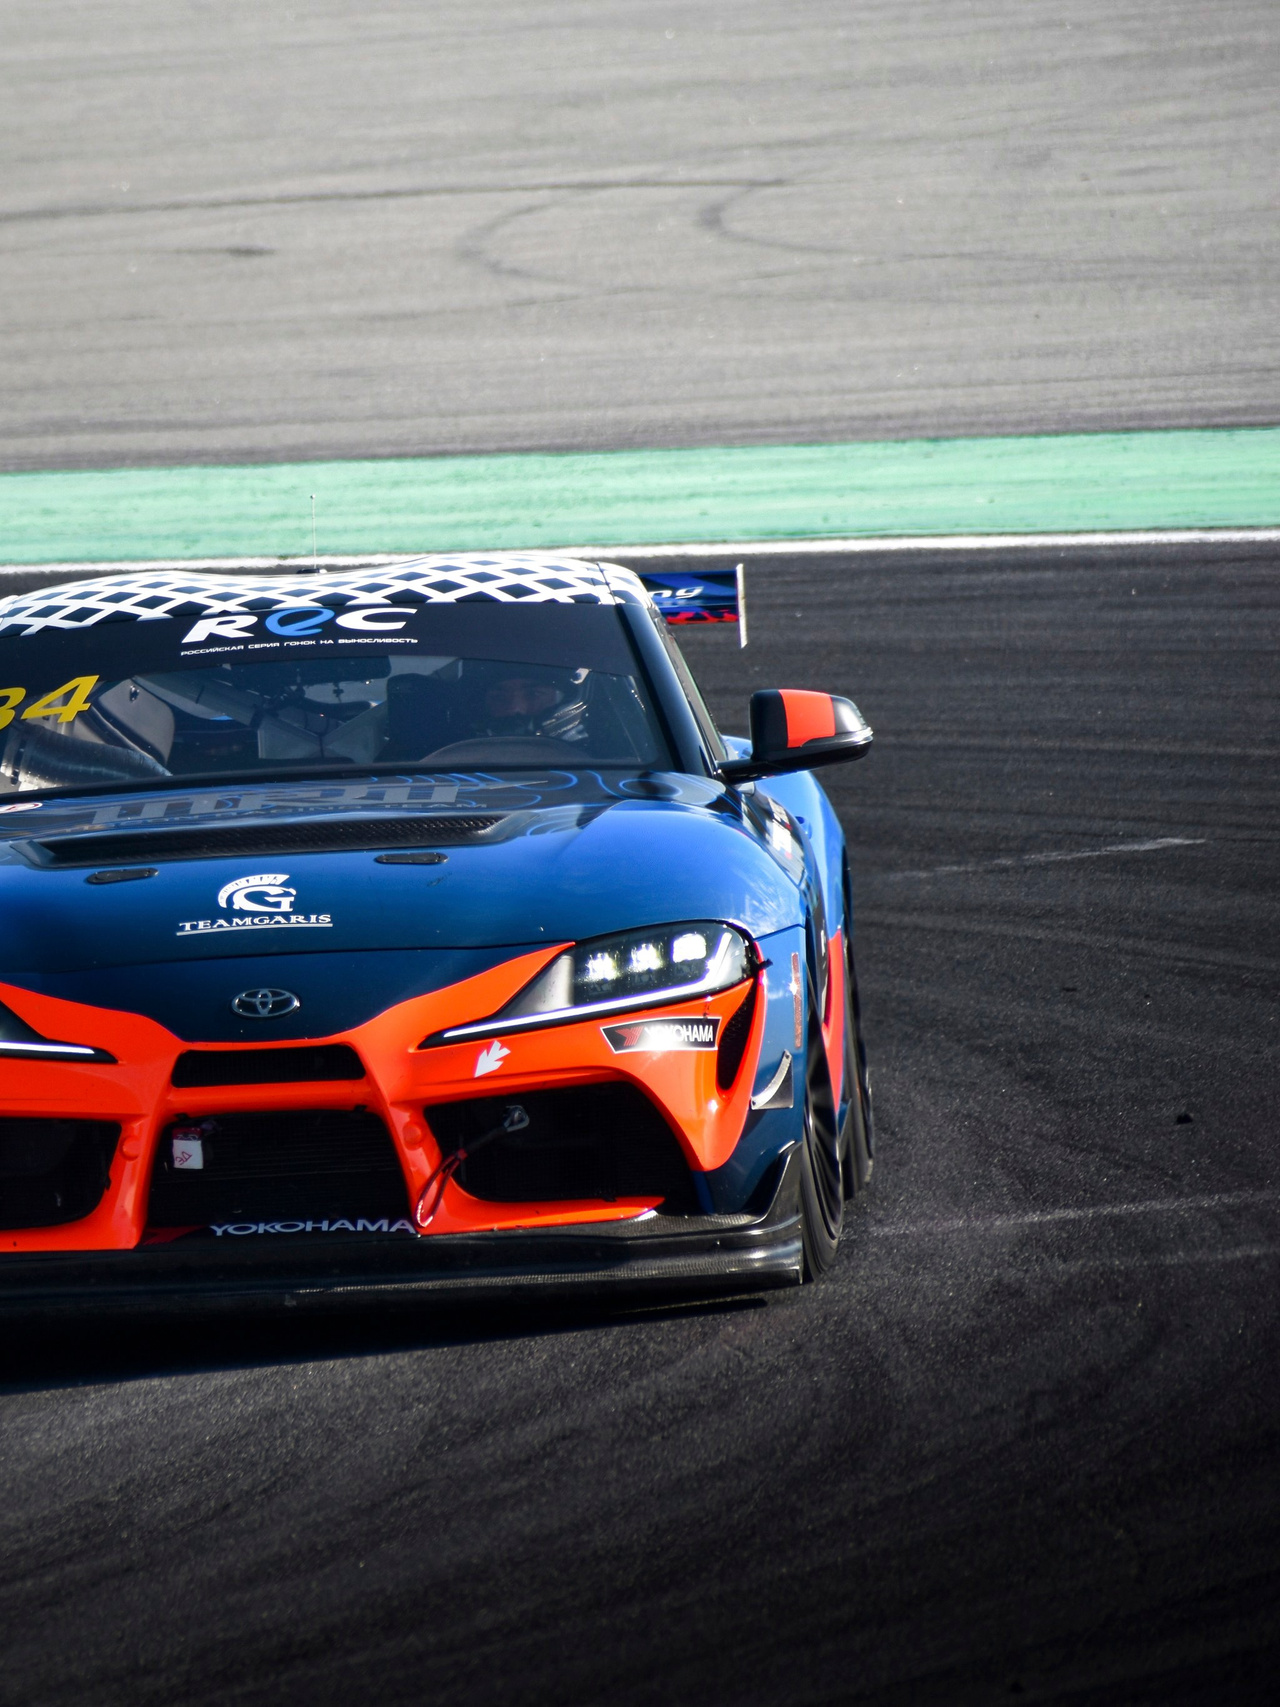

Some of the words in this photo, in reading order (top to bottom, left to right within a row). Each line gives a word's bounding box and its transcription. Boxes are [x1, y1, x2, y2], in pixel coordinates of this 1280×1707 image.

[180, 644, 245, 656] РОССИЙСКАЯ
[248, 642, 280, 650] СЕРИЯ
[179, 914, 332, 932] TEAMGARIS
[644, 1024, 714, 1042] OHAMA
[209, 1218, 417, 1237] YOKOHAMA
